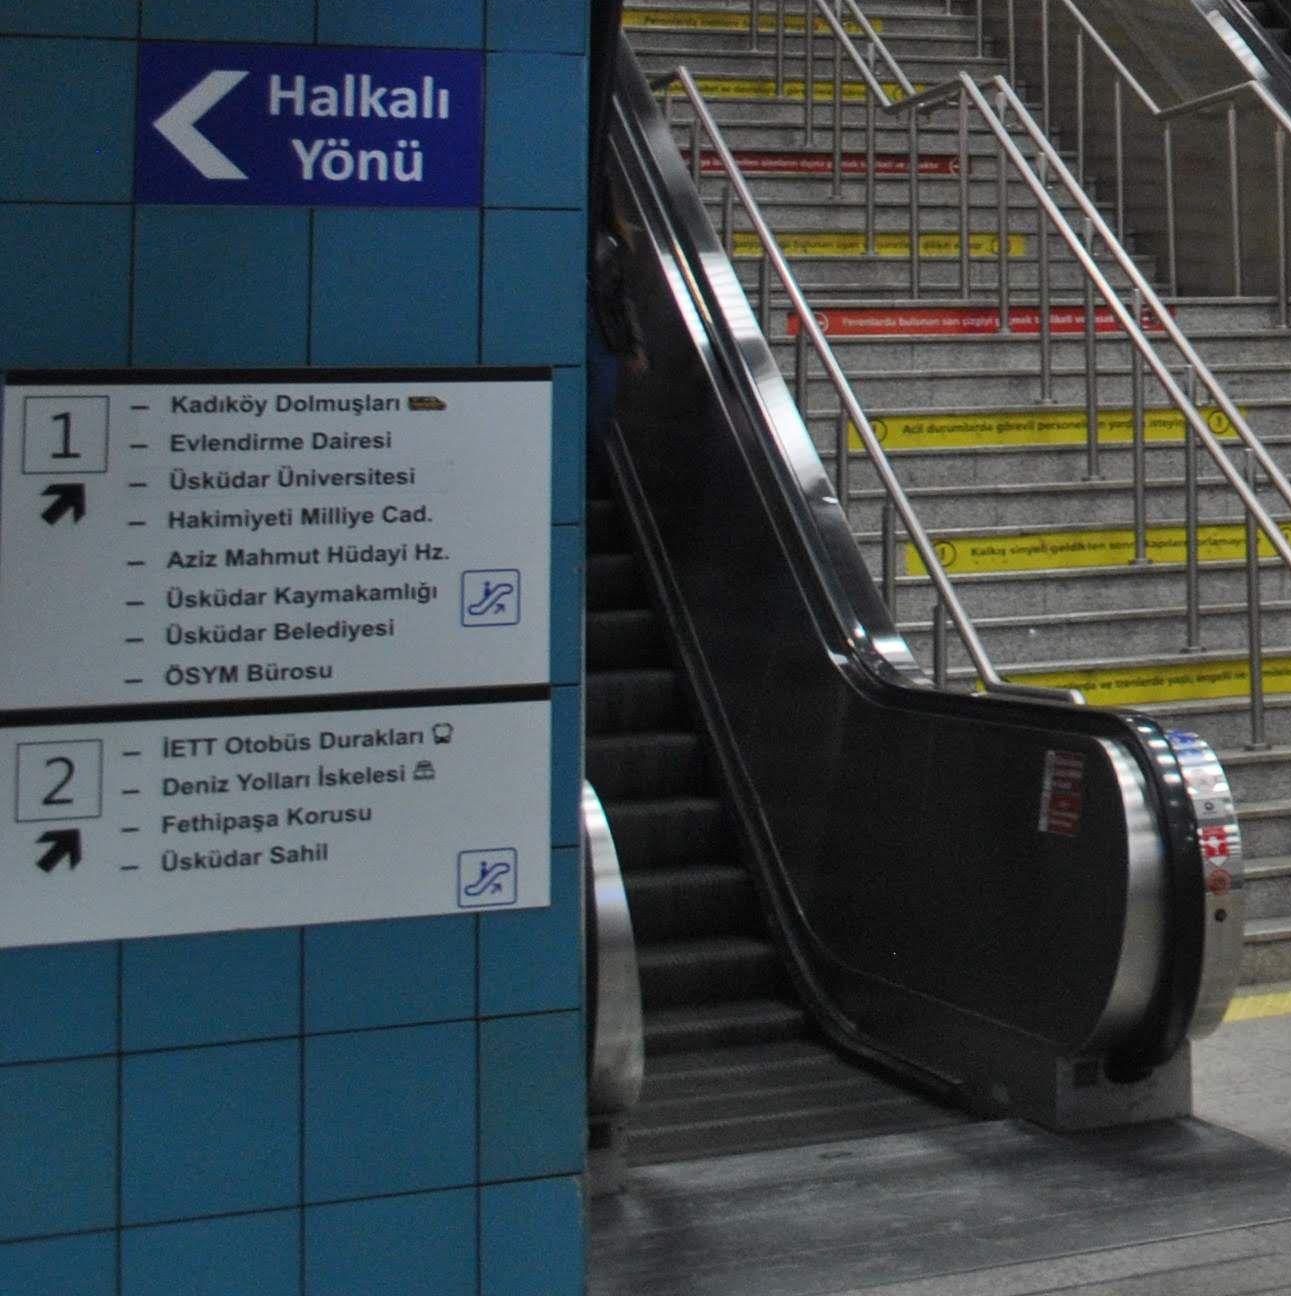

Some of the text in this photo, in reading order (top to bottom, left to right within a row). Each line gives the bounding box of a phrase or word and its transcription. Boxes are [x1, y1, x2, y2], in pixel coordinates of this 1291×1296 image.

[268, 73, 450, 120] Halkalı
[291, 139, 425, 182] Yönü
[171, 394, 400, 417] Kadıköy Dolmuşları
[51, 412, 82, 459] 1
[170, 432, 392, 453] Evlendirme Dairesi
[169, 465, 416, 491] Üsküdar Üniversitesi
[167, 506, 433, 530] Hakimiyeti Milliye Cad.
[167, 544, 450, 568] Aziz Mahmut Hüdayi Hz.
[166, 583, 437, 609] Üsküdar Kaymakamlığı
[166, 619, 395, 646] Üsküdar Belediyesi
[165, 662, 333, 686] ÖSYM Bürosu
[163, 727, 424, 759] İETT Otobüs Durakları
[42, 757, 75, 804] 2
[162, 765, 405, 797] Deniz Yolları İskelesi
[161, 806, 372, 835] Fethipaşa Korusu
[161, 843, 328, 872] Üsküdar Sahil
